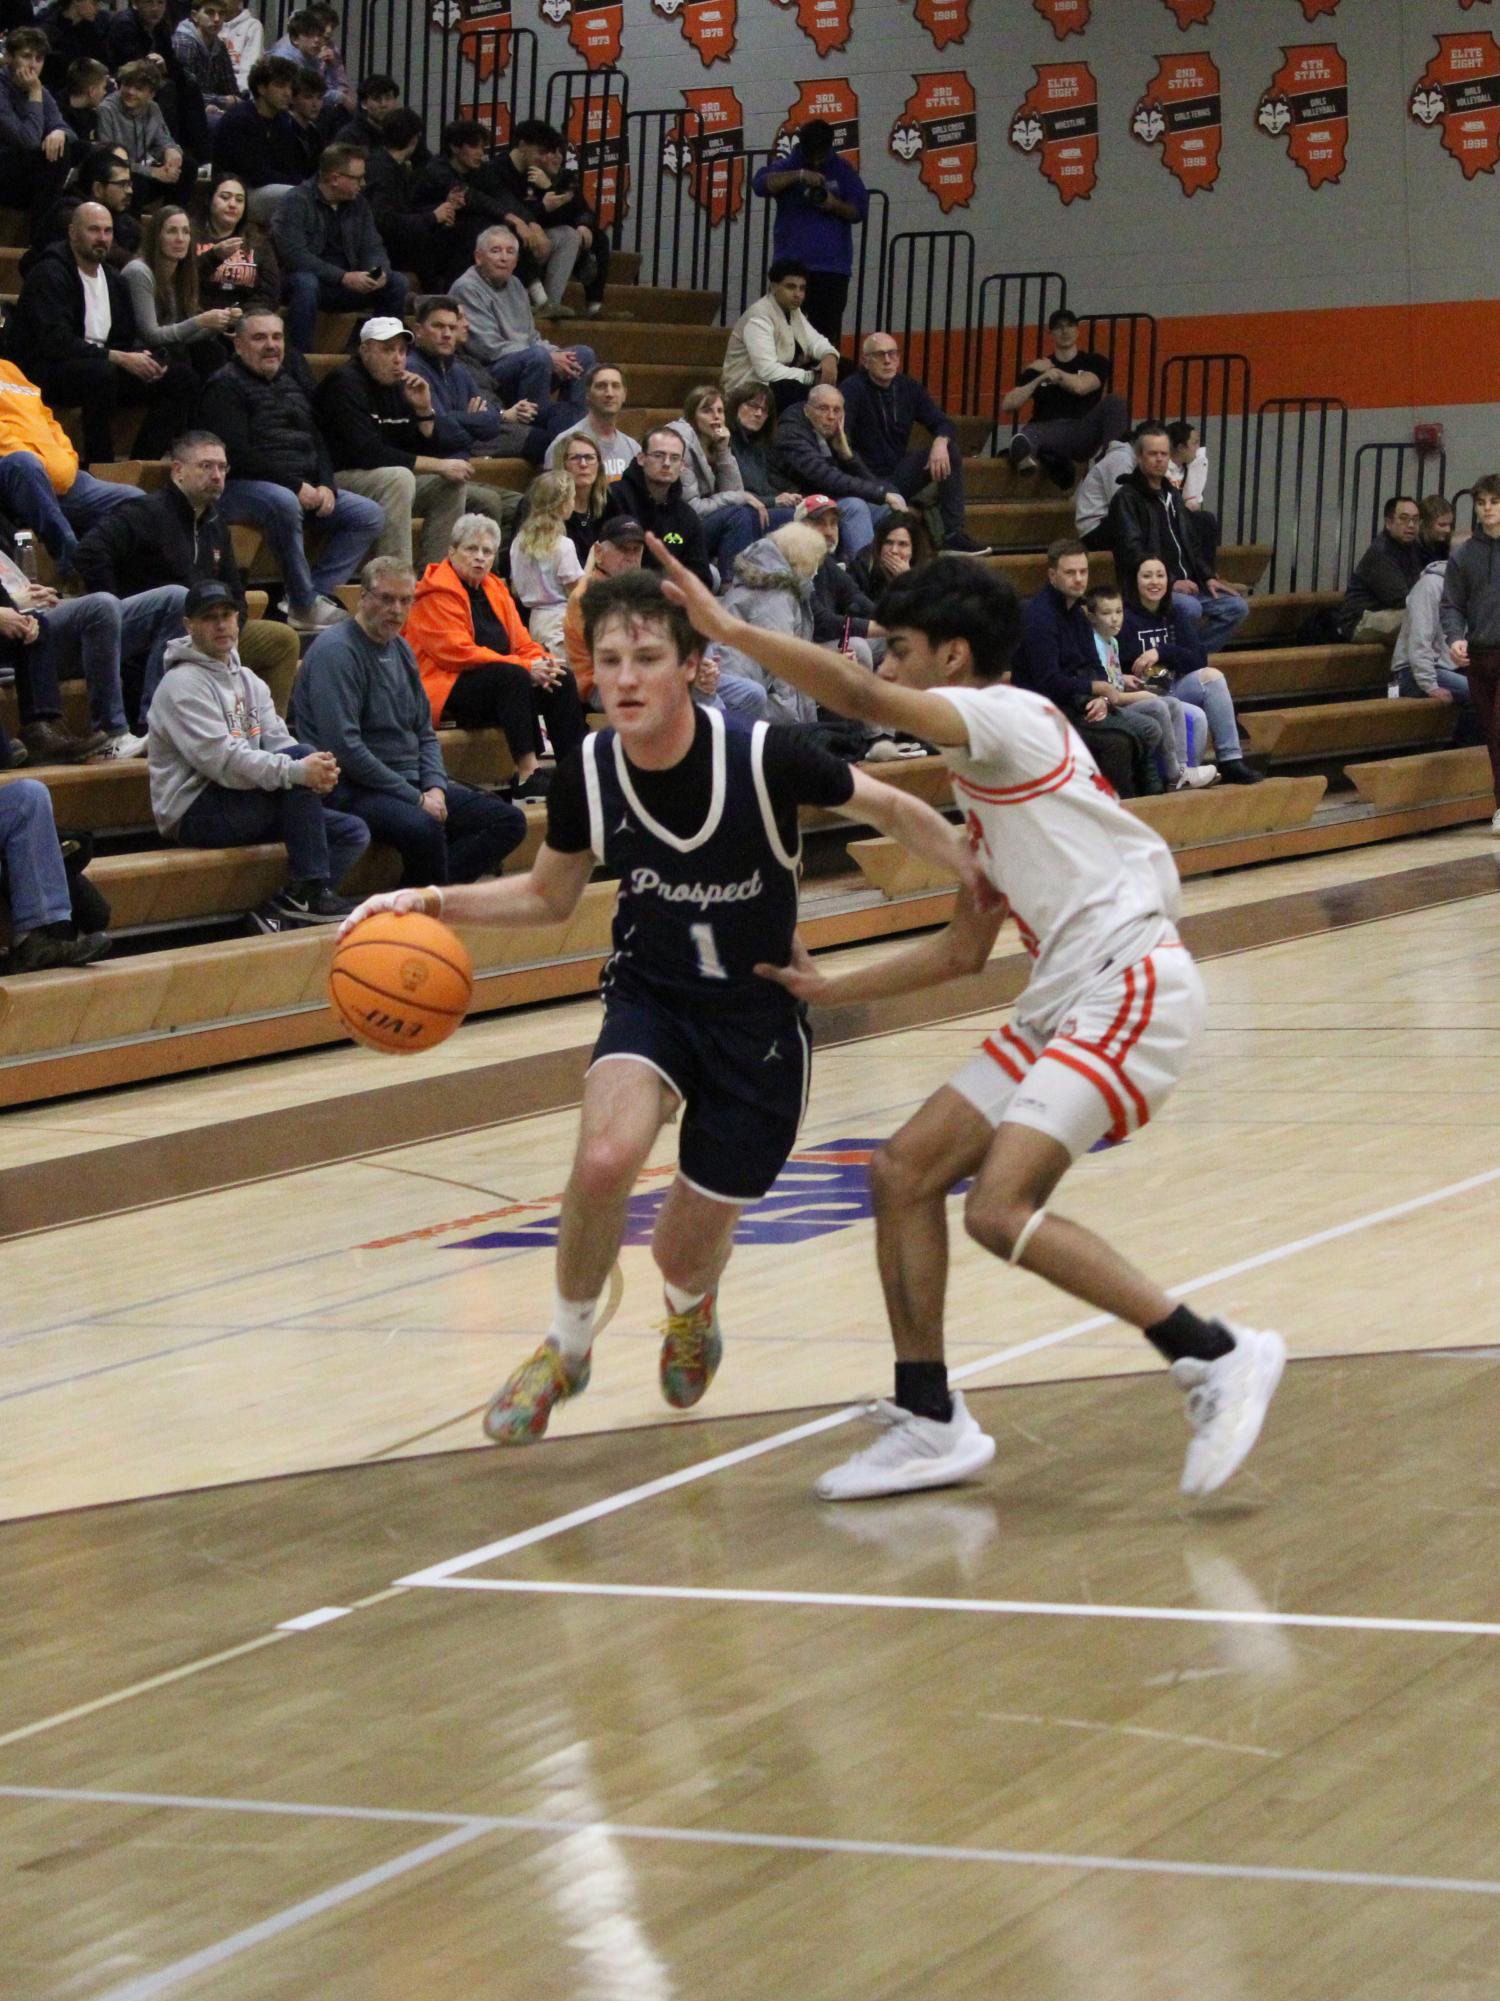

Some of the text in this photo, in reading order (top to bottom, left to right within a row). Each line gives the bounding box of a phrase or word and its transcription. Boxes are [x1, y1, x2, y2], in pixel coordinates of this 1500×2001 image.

[1451, 48, 1482, 59] ELITE
[1301, 59, 1323, 69] 4TH
[1451, 58, 1483, 69] EIGHT
[1176, 68, 1196, 78] 2ND
[1294, 69, 1330, 80] STATE
[1048, 77, 1077, 88] ELITE
[1168, 78, 1204, 89] STATE
[932, 86, 952, 97] 3RD
[1048, 87, 1079, 98] EIGHT
[815, 93, 835, 103] 3RD
[926, 96, 960, 108] STATE
[808, 103, 843, 114] STATE
[631, 867, 763, 912] Prospect
[689, 923, 728, 979] 1
